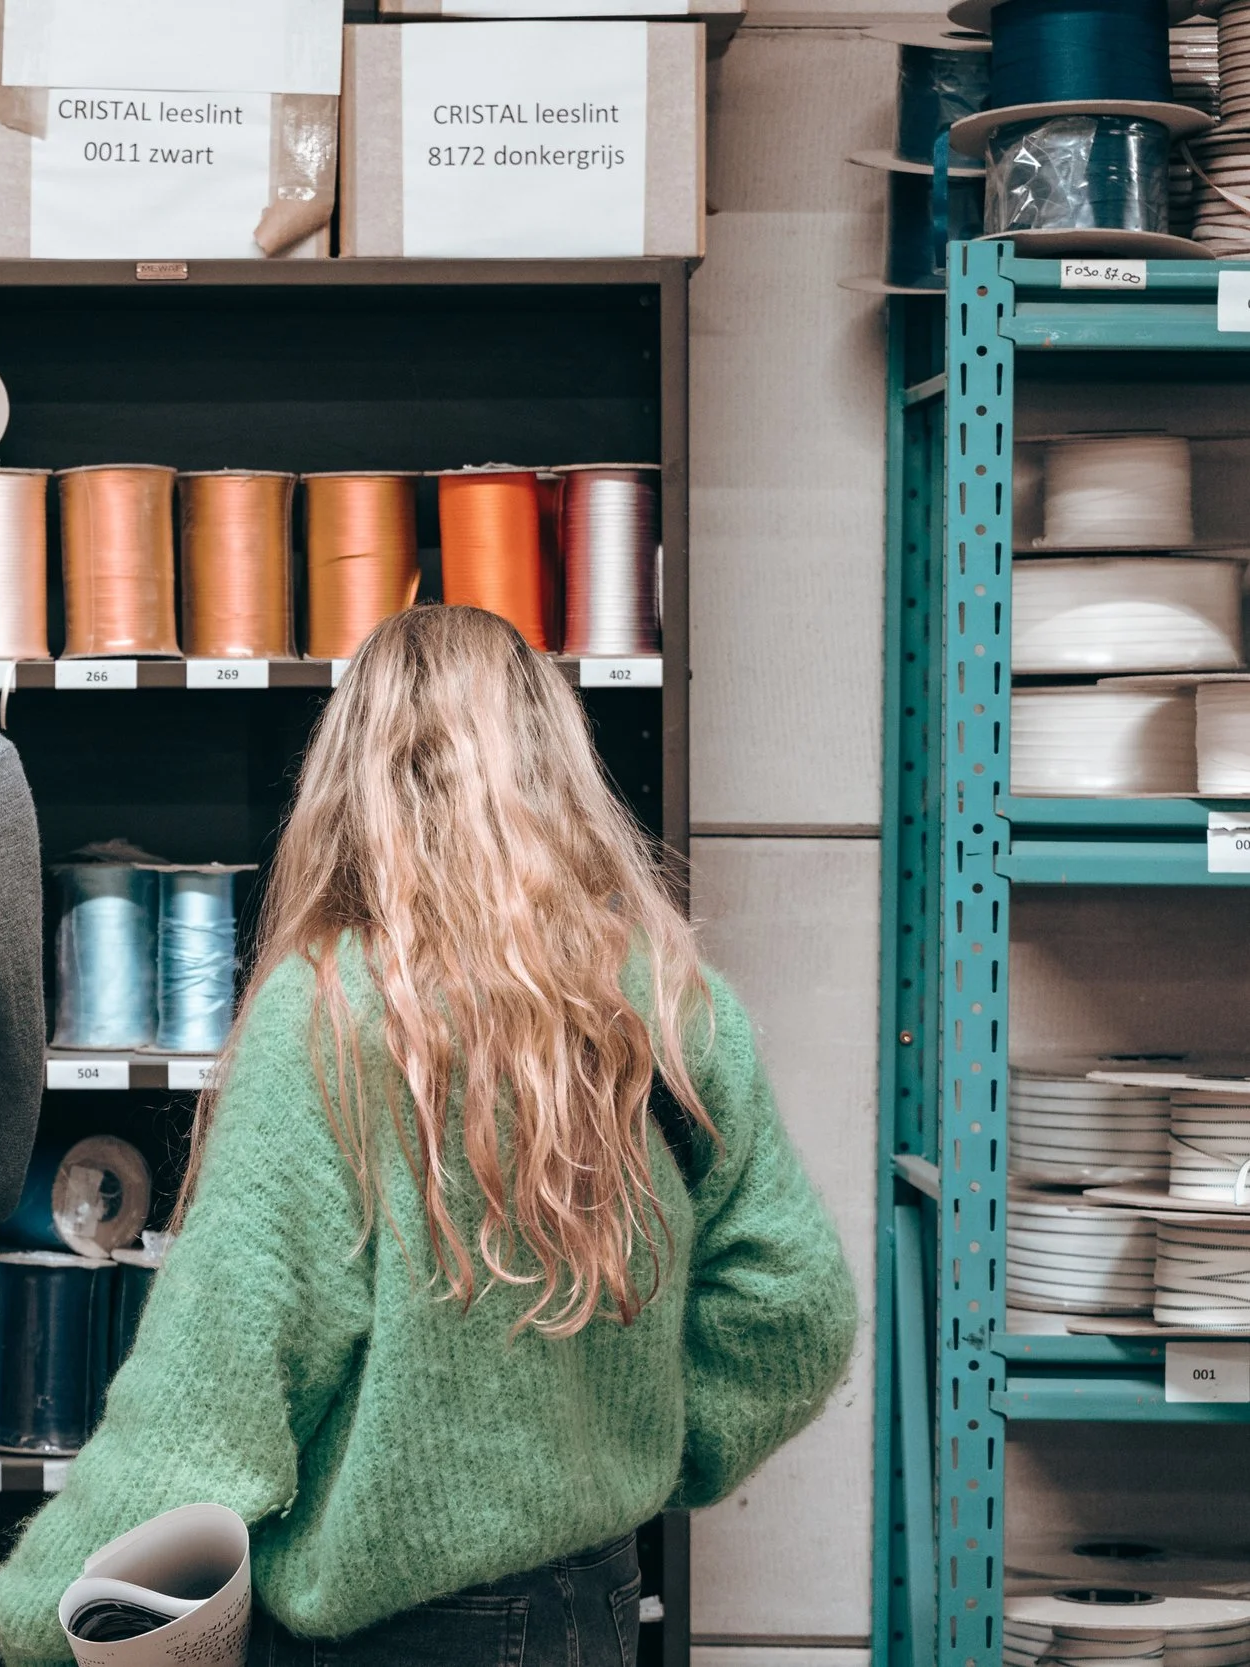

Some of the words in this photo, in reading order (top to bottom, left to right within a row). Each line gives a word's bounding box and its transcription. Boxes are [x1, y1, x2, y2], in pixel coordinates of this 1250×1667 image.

[58, 99, 152, 121] CRISTAL
[160, 103, 243, 125] leeslint
[434, 104, 528, 125] CRISTAL
[536, 103, 619, 124] leeslint
[84, 141, 140, 163] 0011
[149, 146, 214, 165] zwart
[428, 146, 485, 167] 8172
[494, 144, 624, 170] donkergrijs
[86, 671, 108, 682] 266
[217, 669, 239, 680] 269
[609, 670, 631, 680] 402
[77, 1068, 99, 1079] 504
[1192, 1369, 1216, 1380] 001
